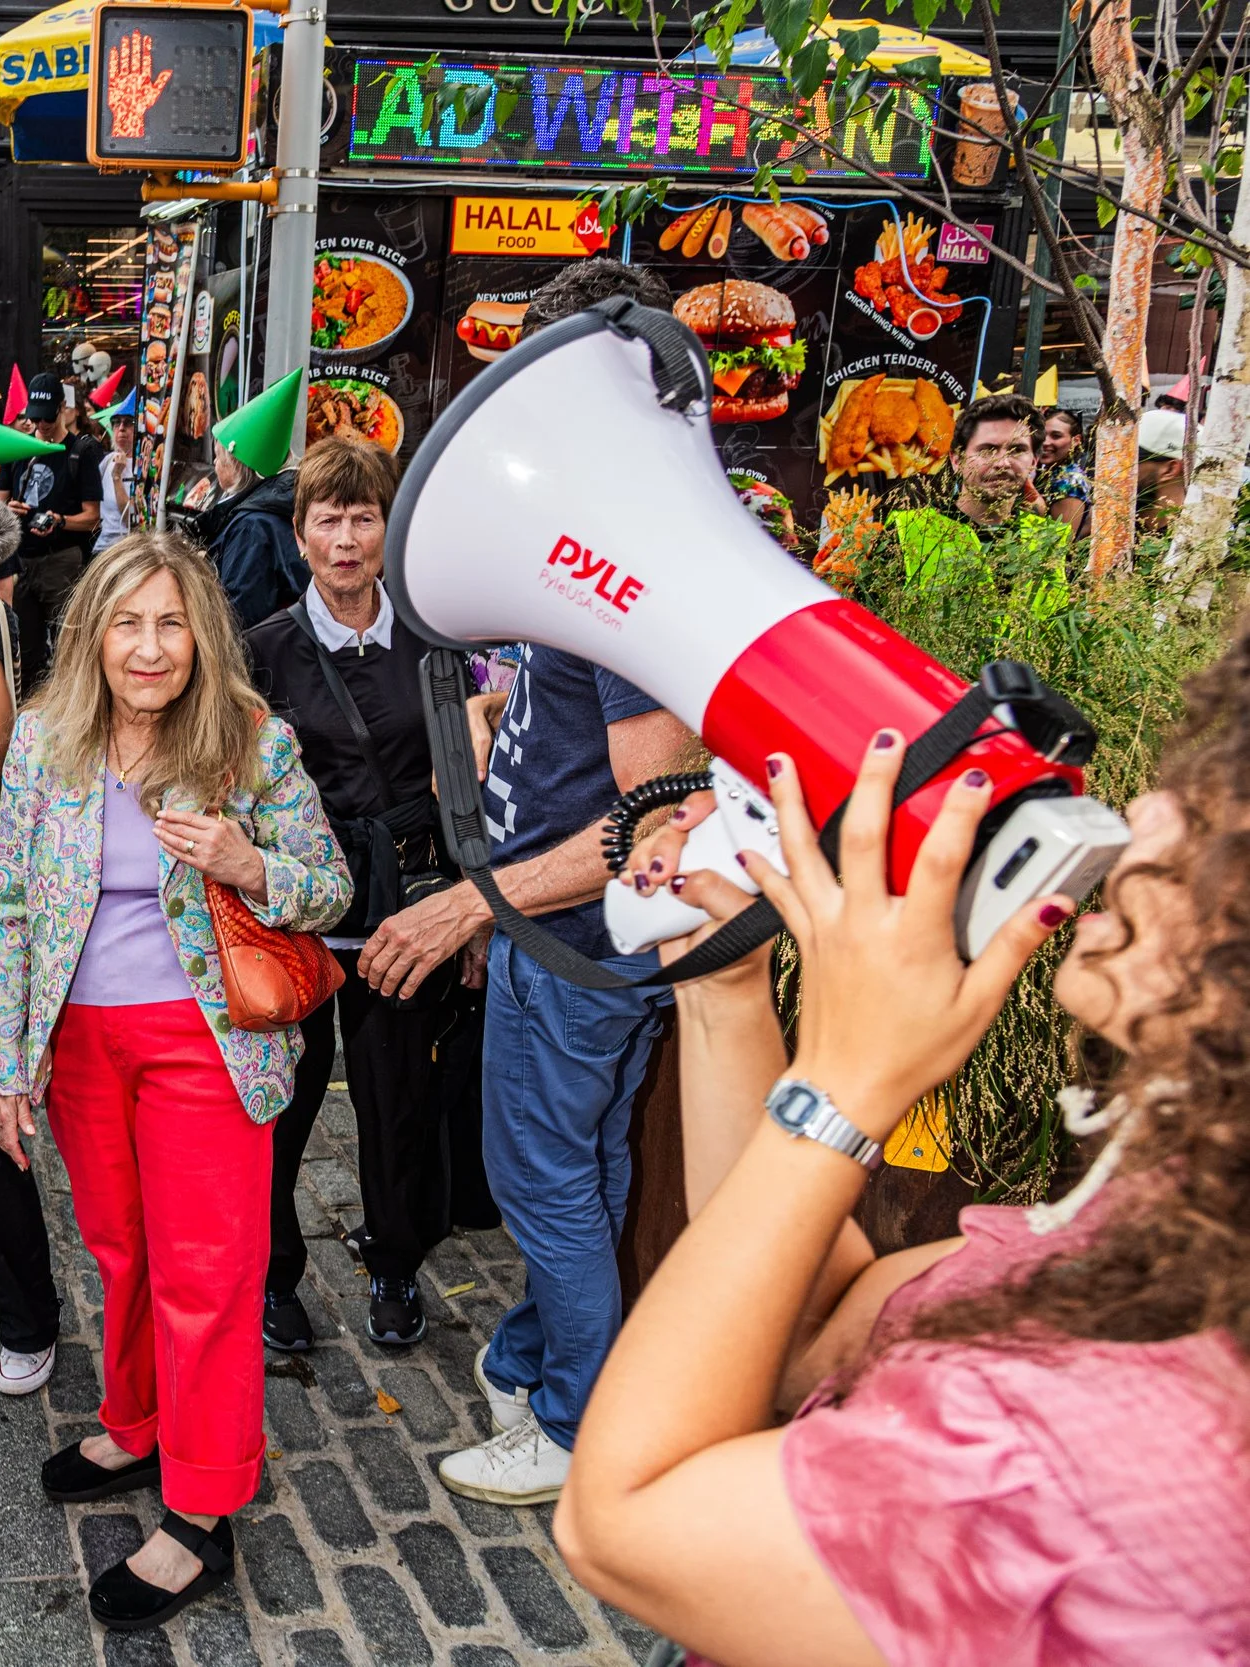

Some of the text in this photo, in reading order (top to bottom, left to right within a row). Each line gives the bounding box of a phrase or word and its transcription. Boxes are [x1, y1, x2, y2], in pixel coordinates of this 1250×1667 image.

[531, 74, 753, 158] WITH
[464, 204, 560, 231] HALAL
[341, 237, 374, 252] OVER
[377, 244, 408, 268] RICE
[497, 236, 536, 248] FOOD
[940, 244, 985, 261] HALAL
[476, 293, 500, 303] NEW
[501, 291, 528, 301] YORK
[844, 290, 916, 350] CHICKEN WINGS W/FRIES
[325, 365, 357, 376] OVER
[360, 368, 390, 386] RICE
[825, 353, 967, 401] CHICKEN TENDERS, FRIES
[726, 467, 768, 483] AMB GYRO
[547, 534, 644, 614] PYLE
[538, 567, 623, 632] PyleUSA.com
